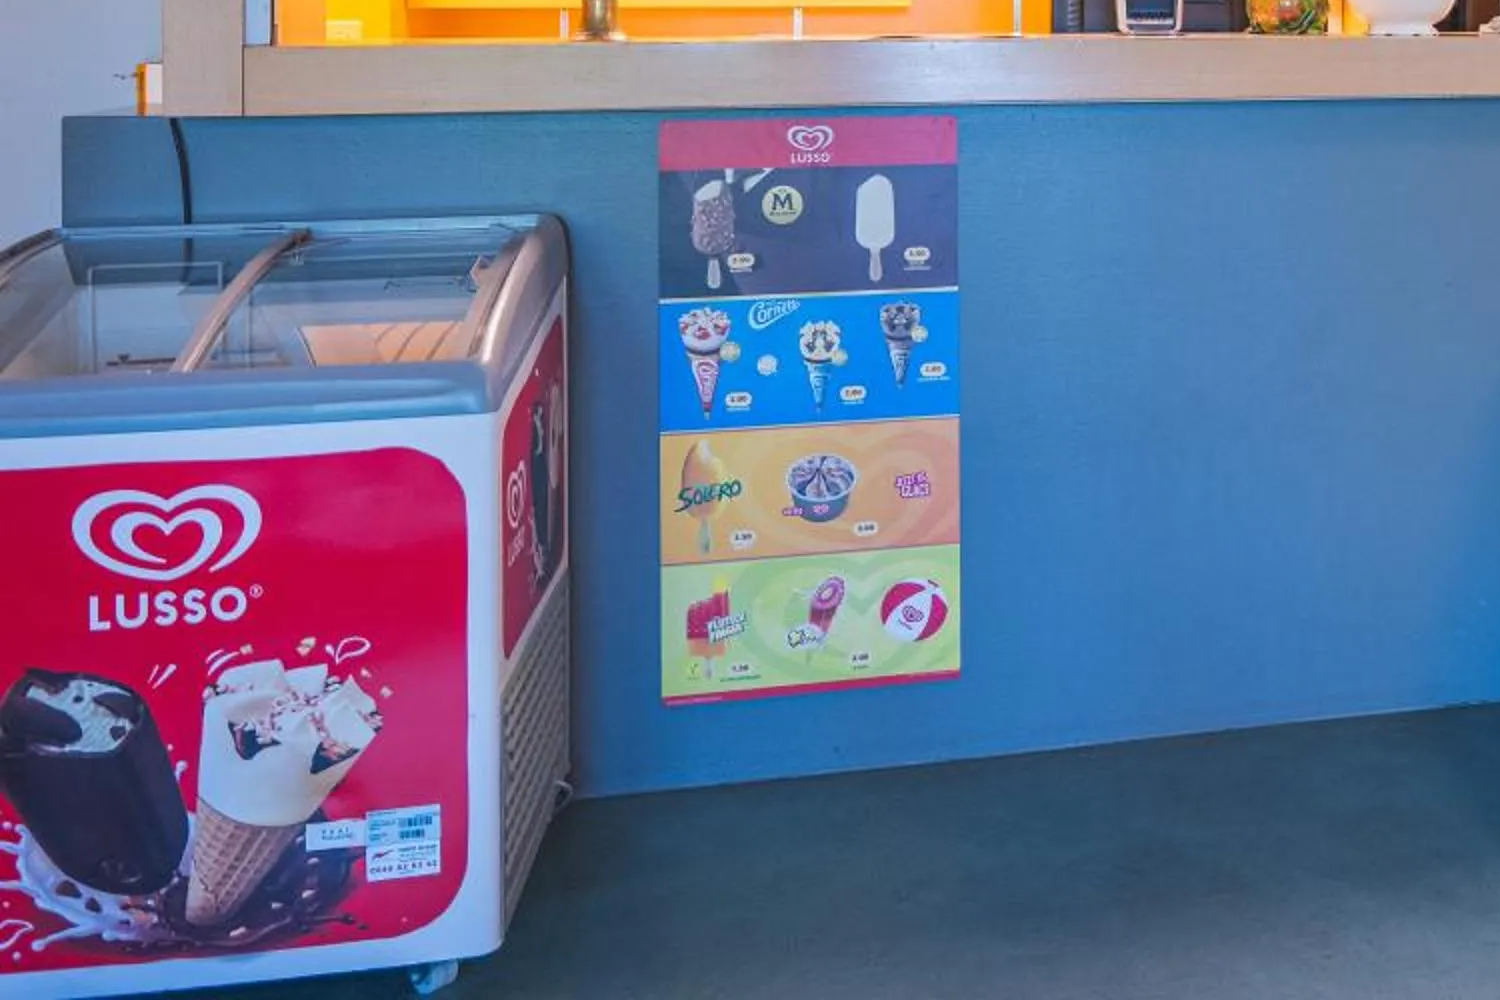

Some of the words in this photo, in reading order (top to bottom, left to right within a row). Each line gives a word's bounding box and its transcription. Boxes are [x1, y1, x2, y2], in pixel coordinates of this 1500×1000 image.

[790, 151, 831, 164] LUSSO
[771, 192, 795, 211] M
[673, 479, 742, 513] SOLERO
[89, 585, 248, 632] LUSSO
